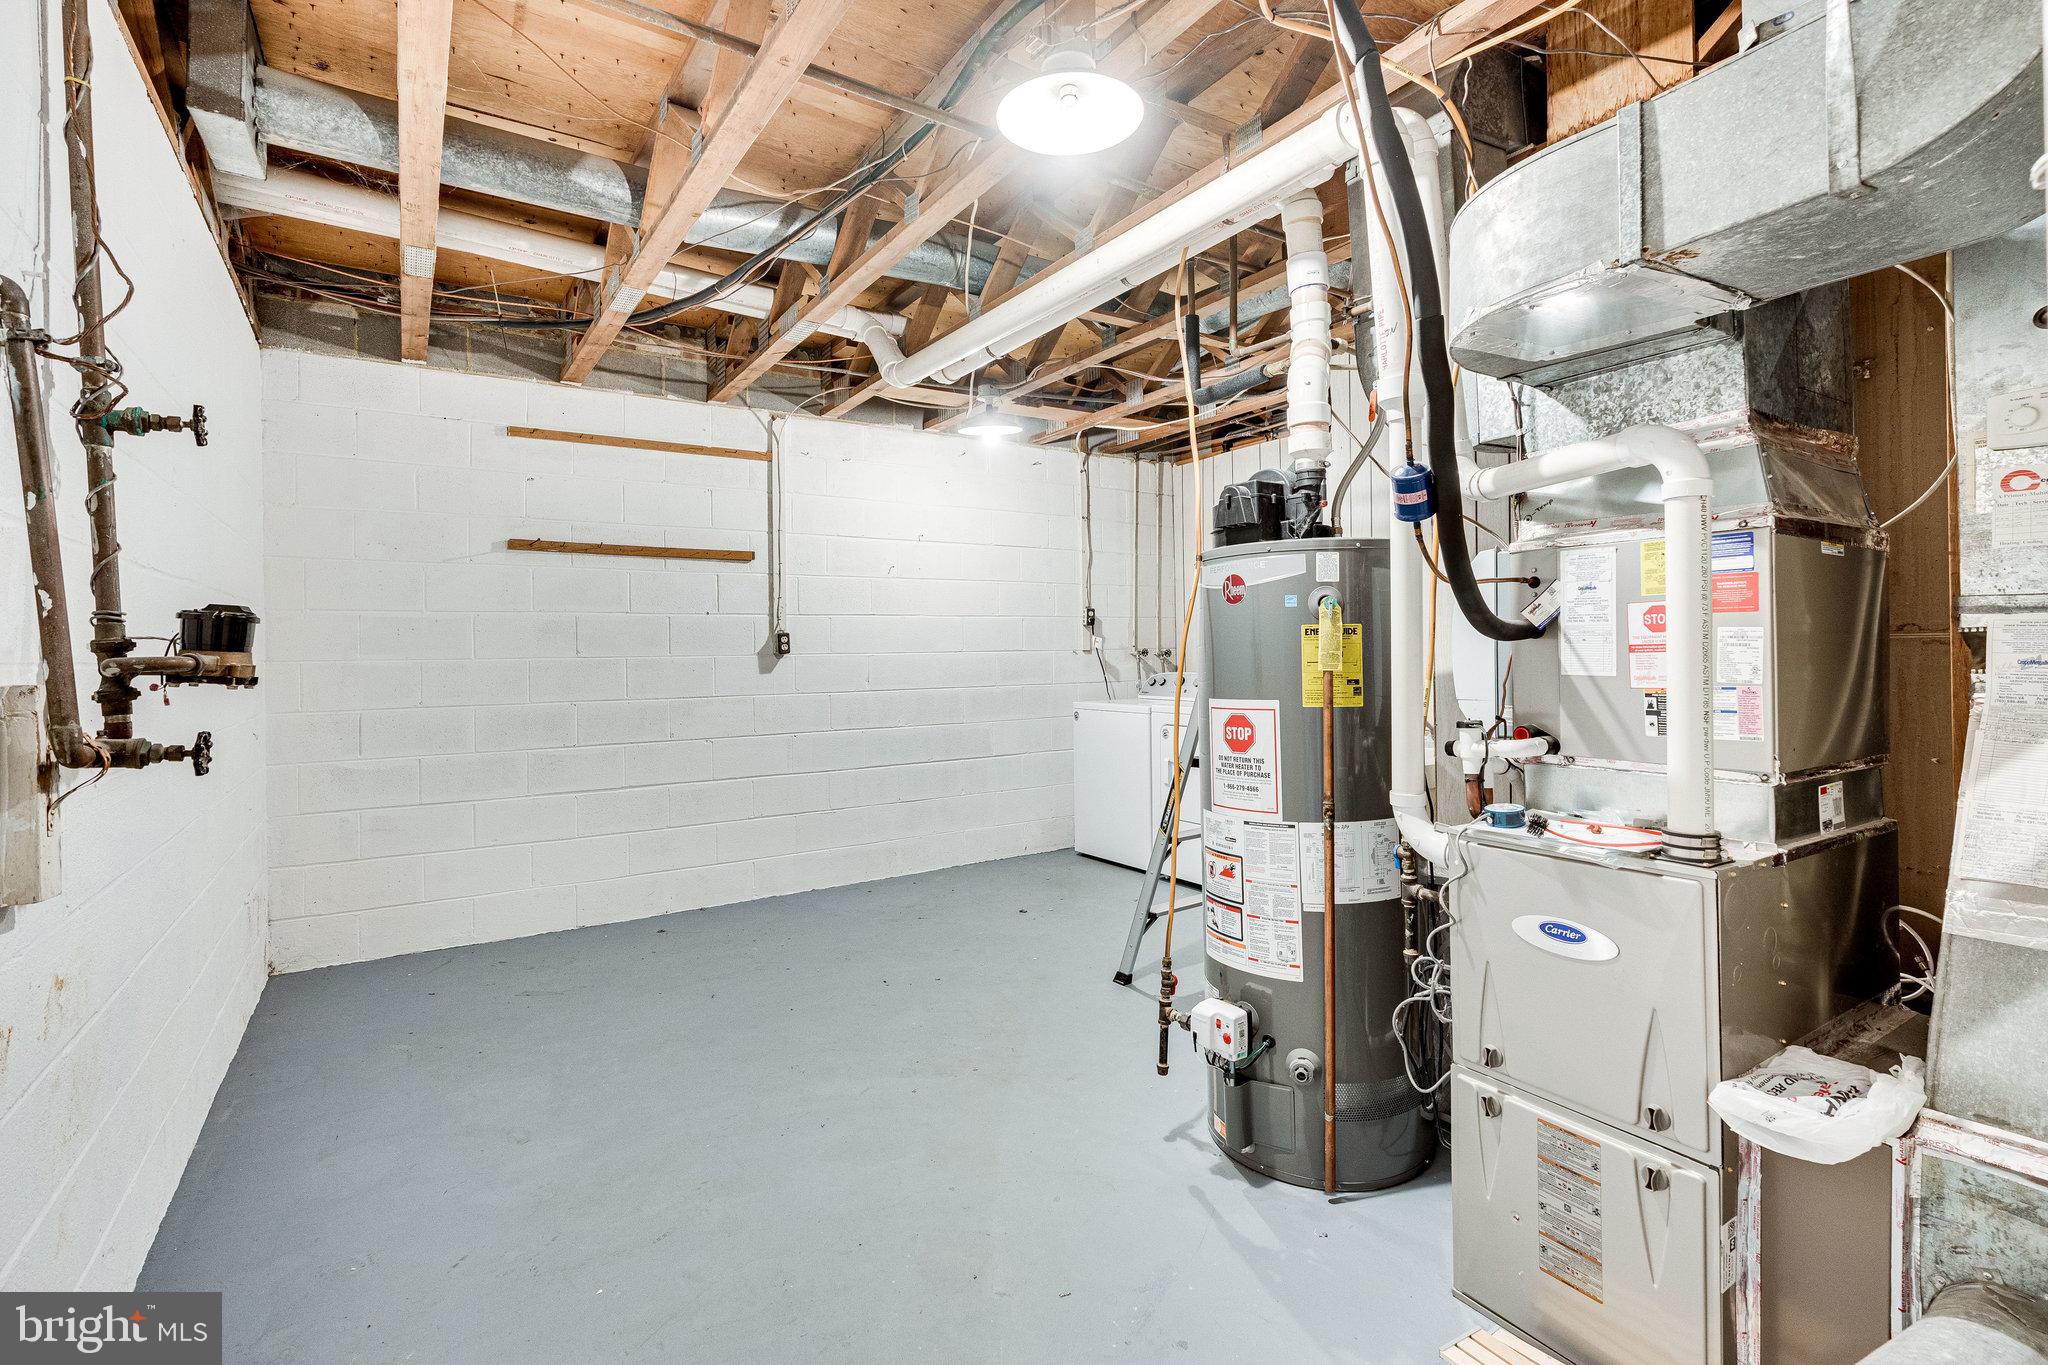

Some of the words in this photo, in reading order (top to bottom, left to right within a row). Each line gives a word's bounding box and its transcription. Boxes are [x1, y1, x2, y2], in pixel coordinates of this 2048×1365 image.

[1224, 574, 1246, 600] Rheem
[1644, 613, 1666, 625] STO
[1226, 726, 1252, 740] STOP
[1545, 925, 1581, 940] Carrier
